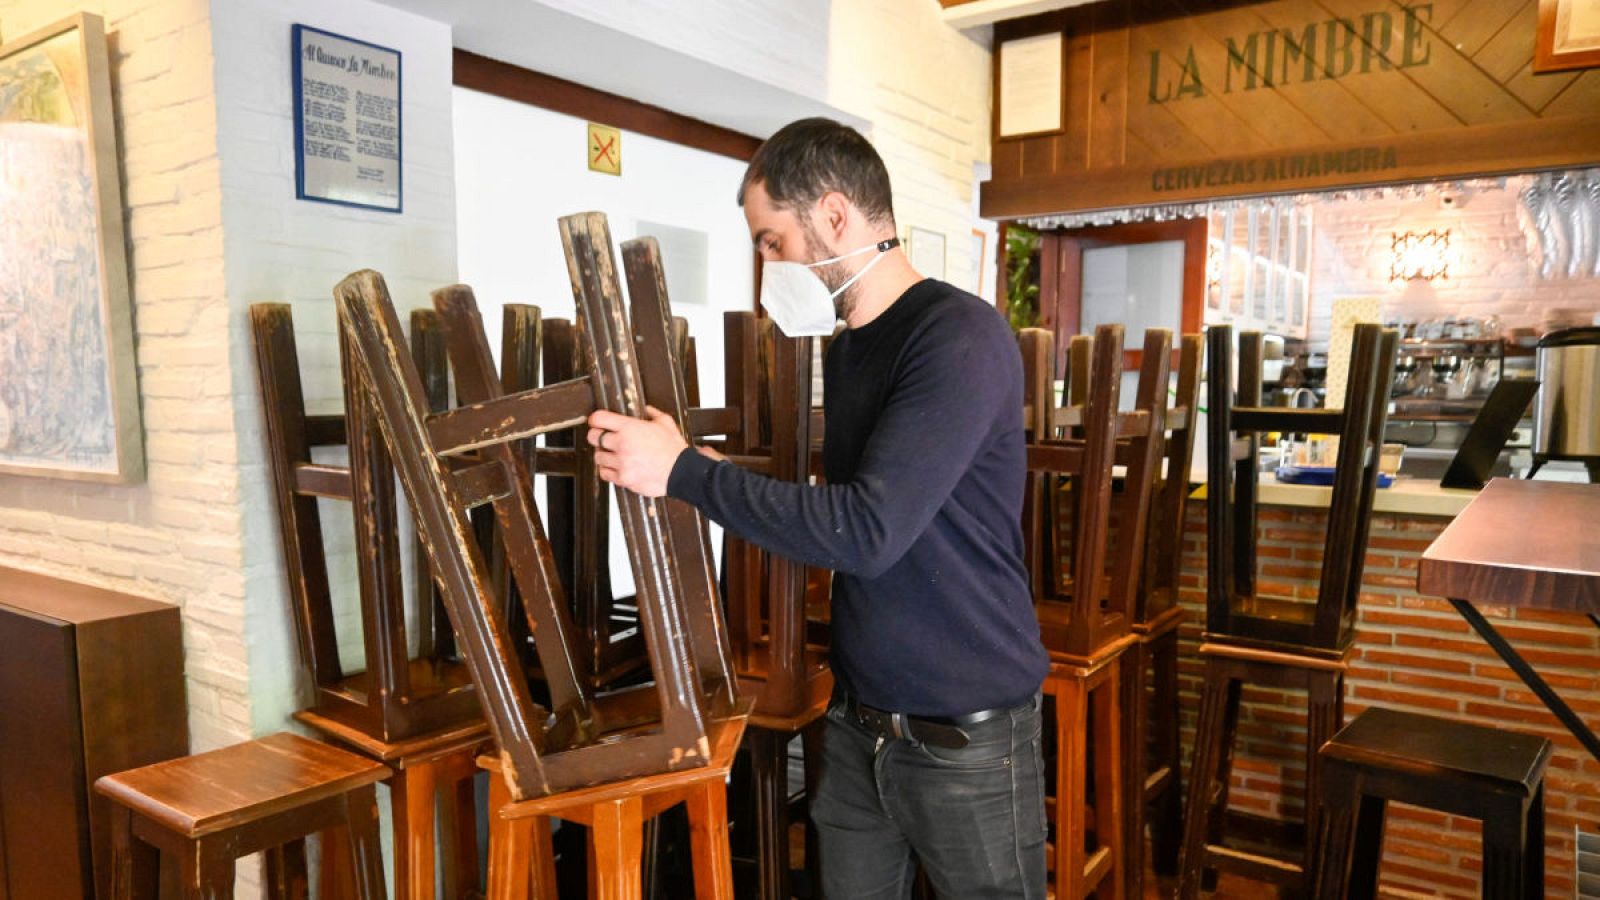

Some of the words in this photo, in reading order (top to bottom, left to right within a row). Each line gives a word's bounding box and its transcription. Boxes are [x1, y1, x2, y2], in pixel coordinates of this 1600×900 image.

[1148, 45, 1206, 105] LA
[1224, 3, 1433, 94] MIMBRE
[1152, 160, 1257, 192] CERVEZAS
[1262, 147, 1398, 181] ALHAMBRA
